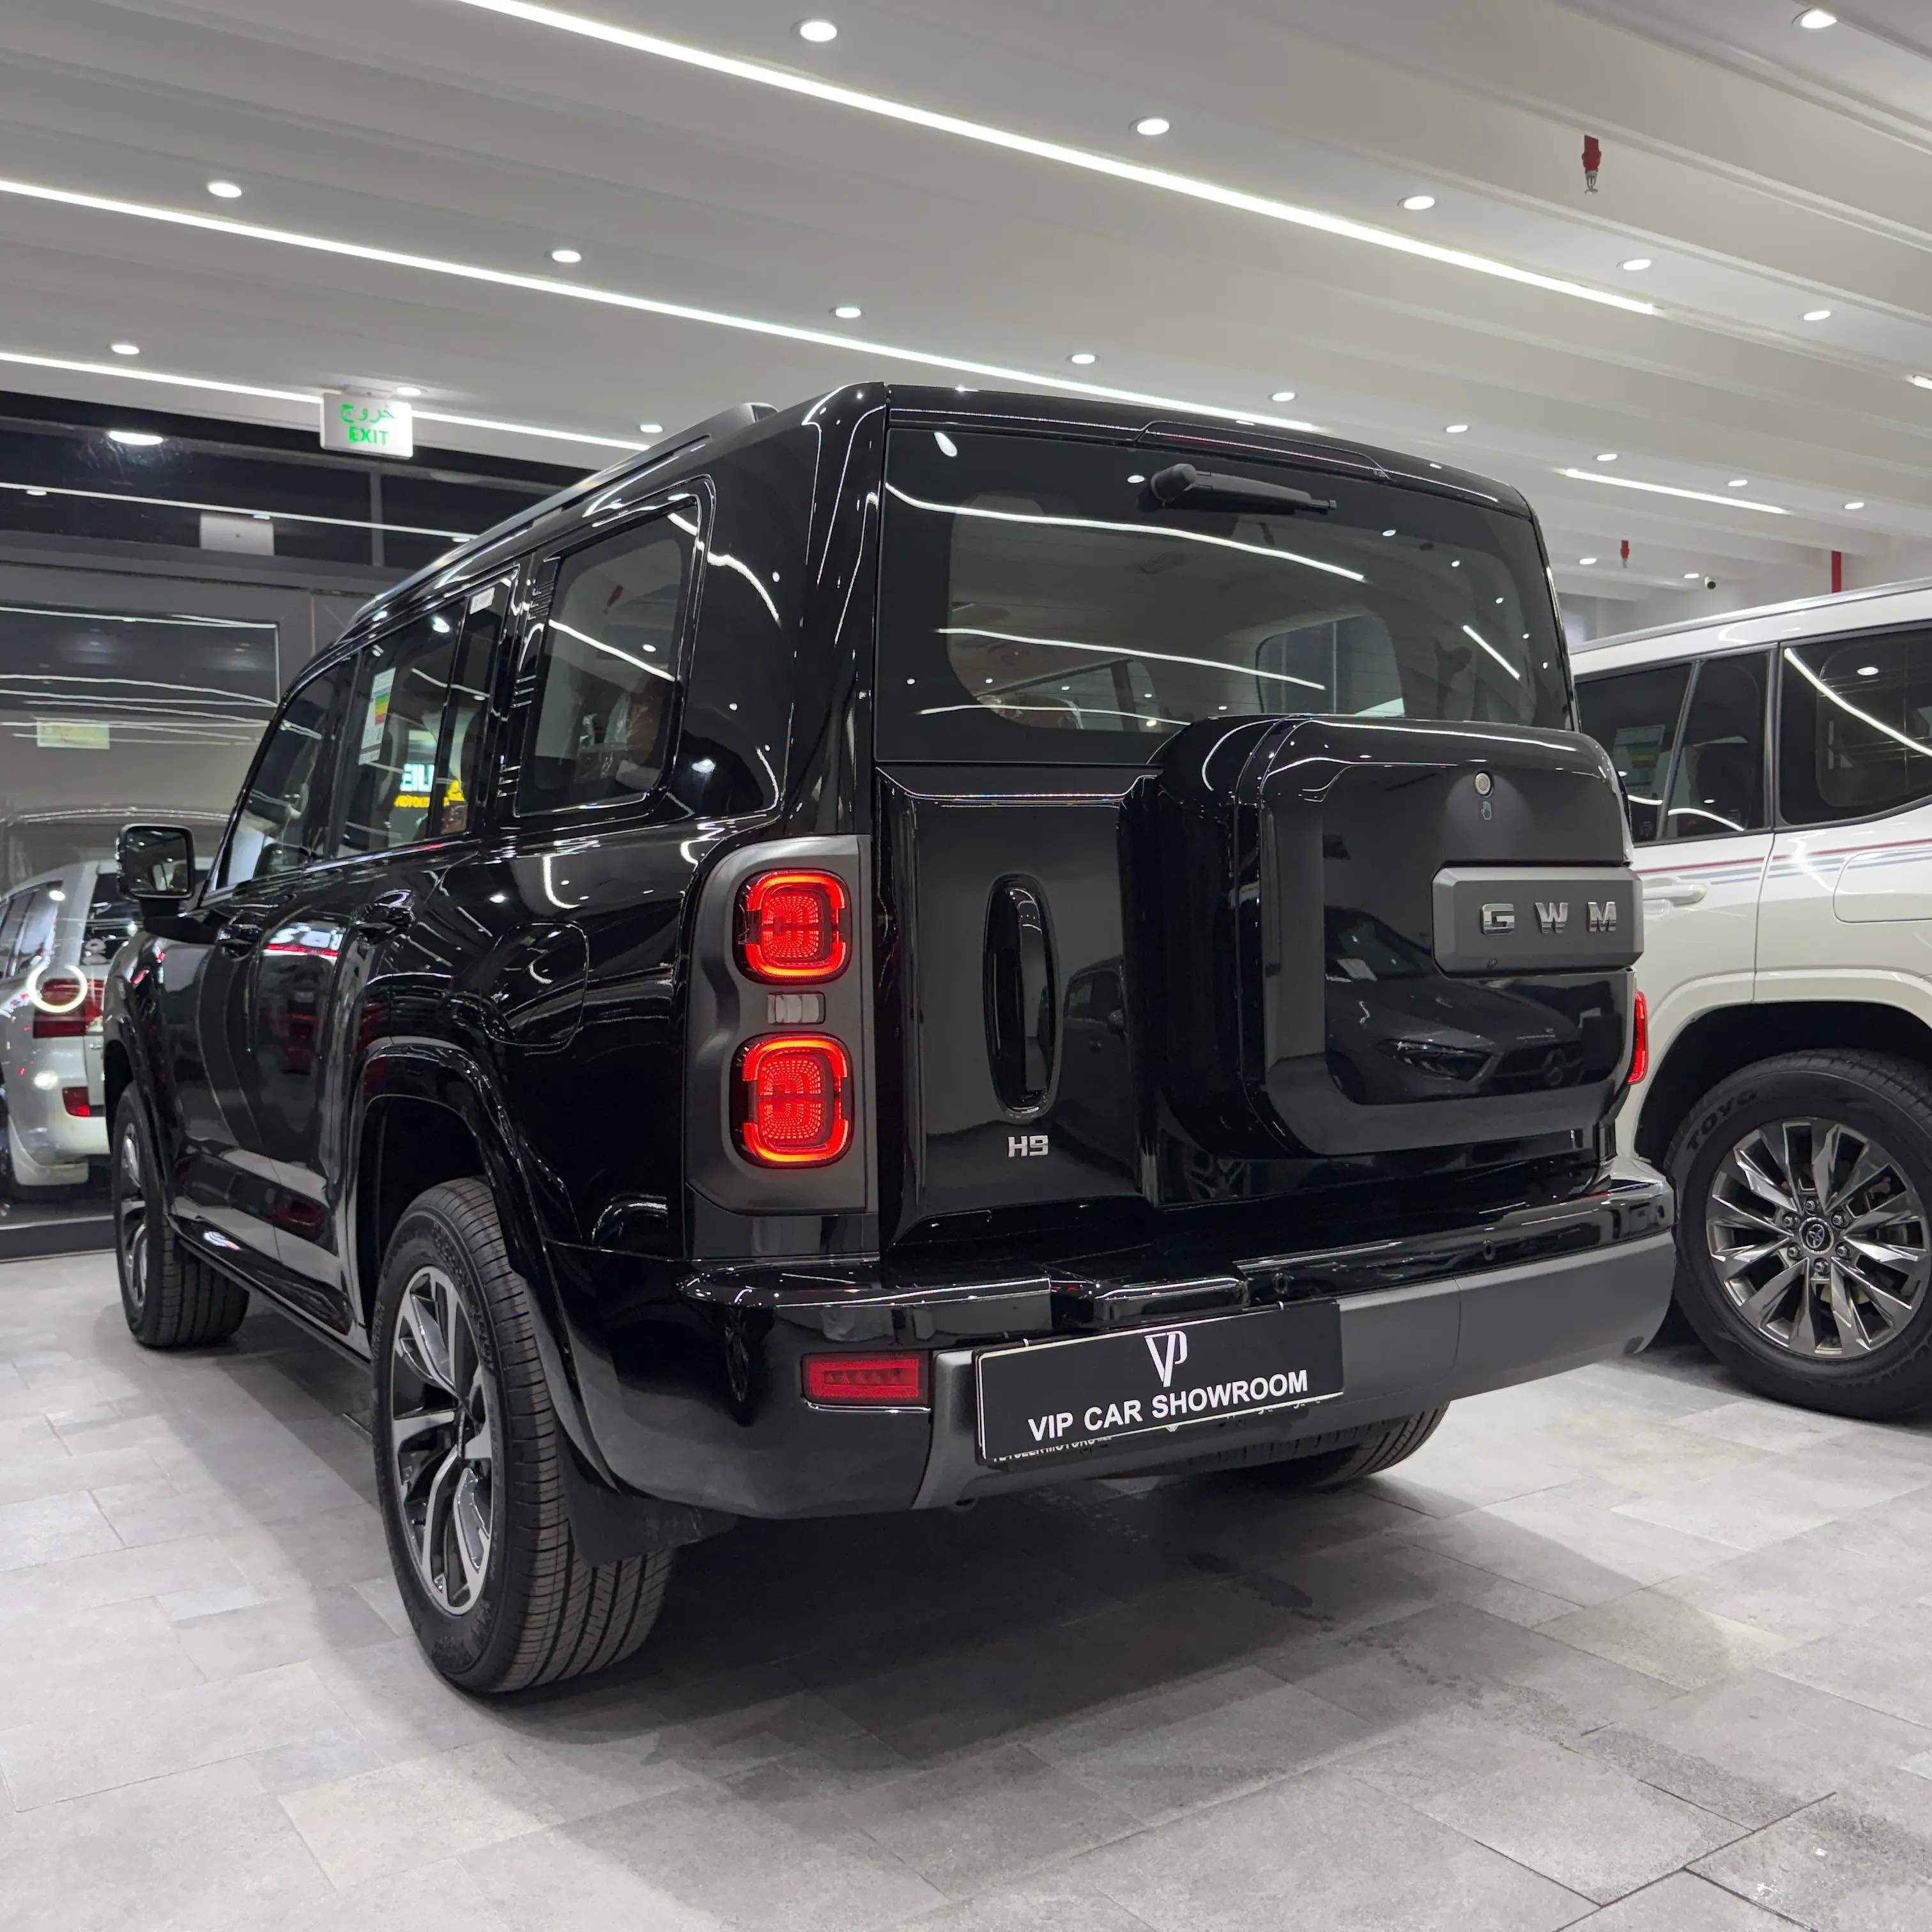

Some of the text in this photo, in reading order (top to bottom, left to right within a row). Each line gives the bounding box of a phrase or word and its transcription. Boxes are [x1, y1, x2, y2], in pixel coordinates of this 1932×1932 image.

[340, 404, 395, 424] خروج
[348, 426, 389, 446] EXIT
[1686, 1089, 1757, 1150] TOYO
[1008, 1135, 1048, 1157] H9
[1028, 1412, 1073, 1441] VIP
[1084, 1399, 1143, 1431] CAR
[1151, 1369, 1308, 1419] SHOWROOM
